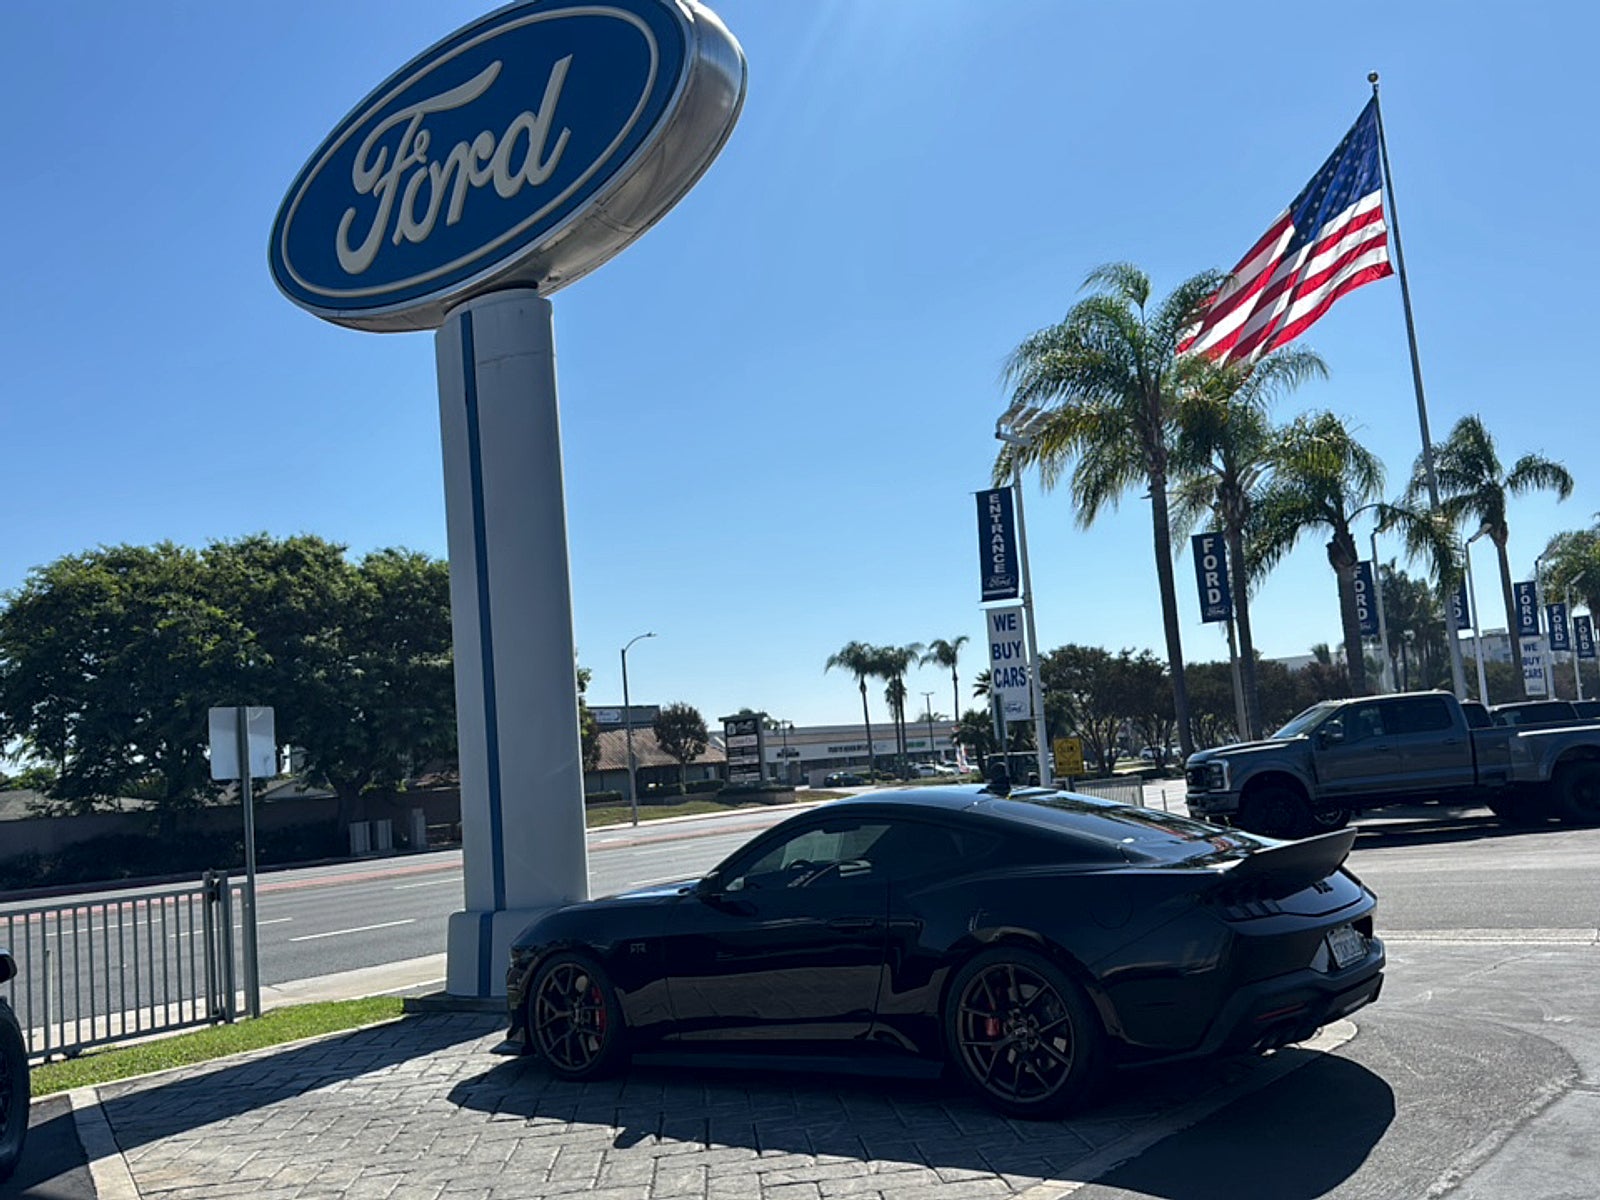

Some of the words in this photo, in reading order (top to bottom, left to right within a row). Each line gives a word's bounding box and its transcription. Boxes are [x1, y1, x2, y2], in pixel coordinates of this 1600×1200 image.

[335, 53, 574, 276] Ford
[989, 493, 1005, 573] ENTRANCE
[1202, 538, 1221, 605] FORD
[1520, 585, 1533, 626] FORD
[993, 613, 1017, 632] WE
[1552, 606, 1564, 641] FORD
[1578, 619, 1590, 650] FORD
[991, 640, 1022, 660] BUY
[993, 666, 1027, 688] CARS
[1524, 668, 1543, 679] CARS
